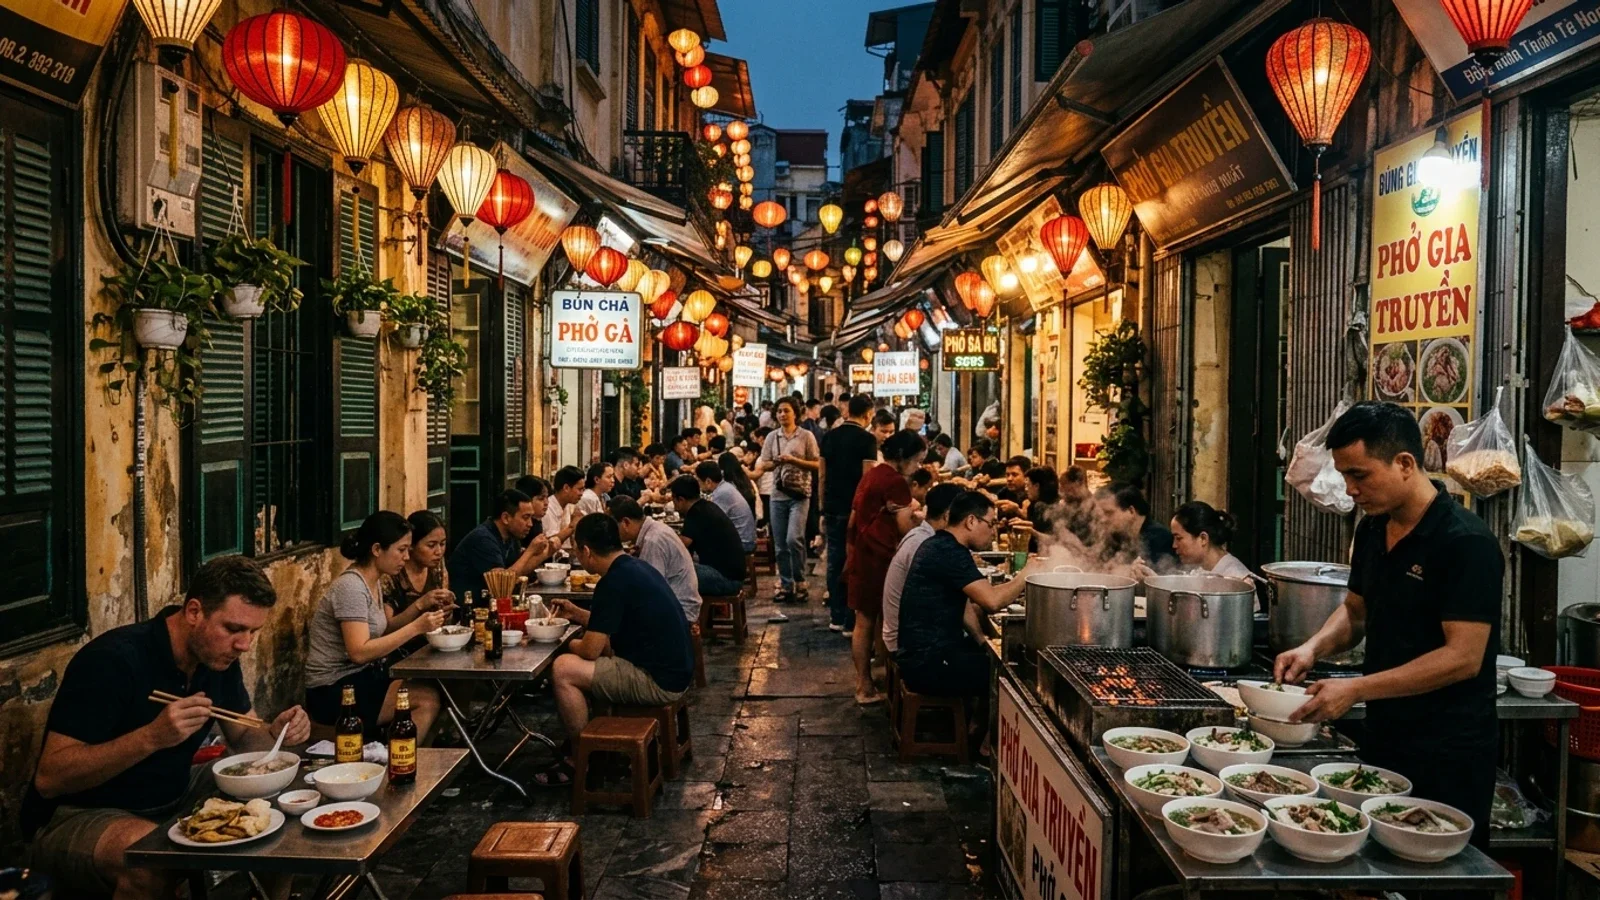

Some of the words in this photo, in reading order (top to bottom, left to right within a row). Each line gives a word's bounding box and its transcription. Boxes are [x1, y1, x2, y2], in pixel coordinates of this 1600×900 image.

[1377, 221, 1421, 279] PHỞ
[1427, 223, 1472, 268] GIA
[1375, 269, 1472, 334] TRUYỀN
[1021, 745, 1039, 823] GIA
